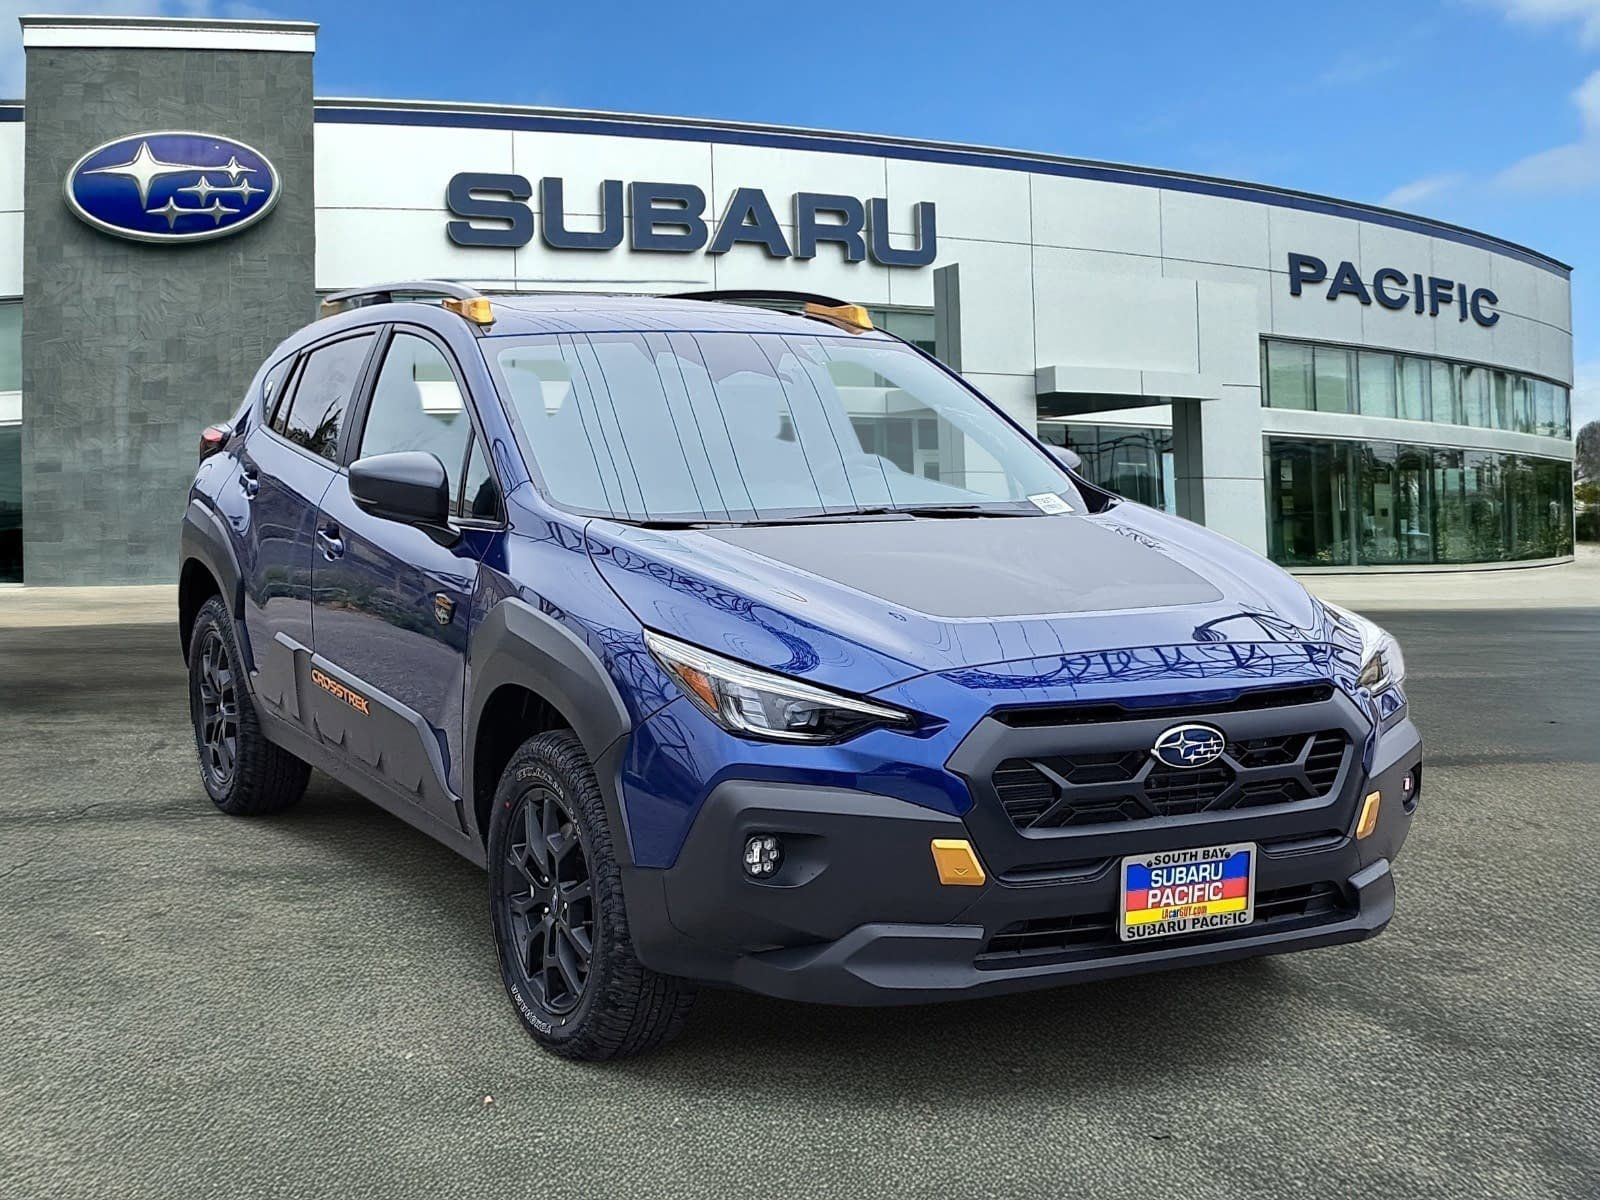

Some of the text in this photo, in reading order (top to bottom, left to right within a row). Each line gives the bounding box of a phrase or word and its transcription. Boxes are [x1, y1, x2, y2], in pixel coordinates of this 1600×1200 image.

[446, 171, 937, 268] SUBARU
[1287, 252, 1500, 328] PACIFIC
[311, 669, 370, 716] CROSSTREK
[1154, 848, 1227, 866] SOUTH BAY
[1151, 862, 1223, 888] SUBARU
[1147, 882, 1224, 909] PACIFIC
[1127, 911, 1248, 939] SUBARU PACIFIC
